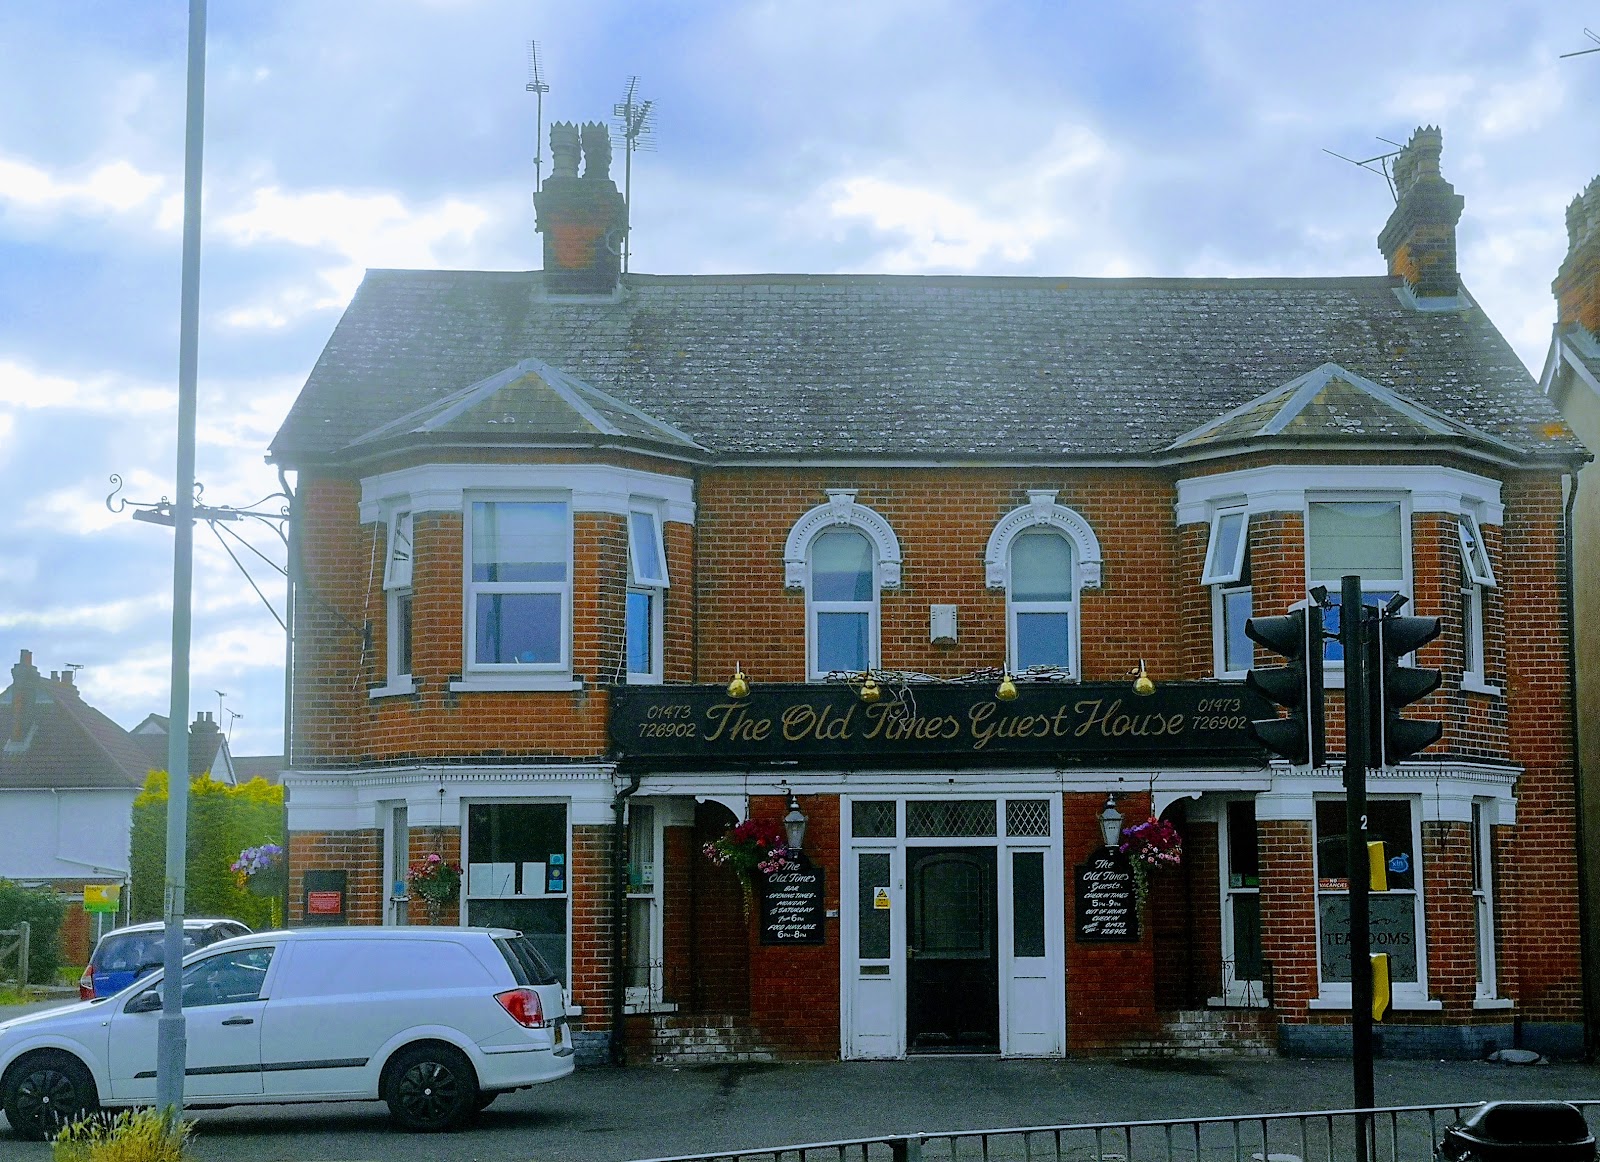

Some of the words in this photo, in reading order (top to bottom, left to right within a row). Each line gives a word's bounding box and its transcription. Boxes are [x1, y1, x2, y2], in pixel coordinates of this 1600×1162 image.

[1198, 698, 1240, 712] 01473
[647, 705, 691, 720] 01473
[704, 702, 771, 741] The
[781, 702, 857, 742] Old
[863, 700, 960, 740] Times
[968, 700, 1070, 750] Guest
[1074, 698, 1184, 738] House
[1192, 716, 1248, 730] 726902
[638, 722, 696, 738] 726902
[1360, 815, 1368, 830] 2
[782, 861, 800, 871] The
[1095, 860, 1114, 869] The
[768, 873, 789, 883] Old
[789, 874, 816, 883] Times
[1083, 871, 1102, 880] Old
[1103, 872, 1129, 880] Times
[1090, 882, 1120, 892] Guests
[1366, 932, 1410, 945] OOMS
